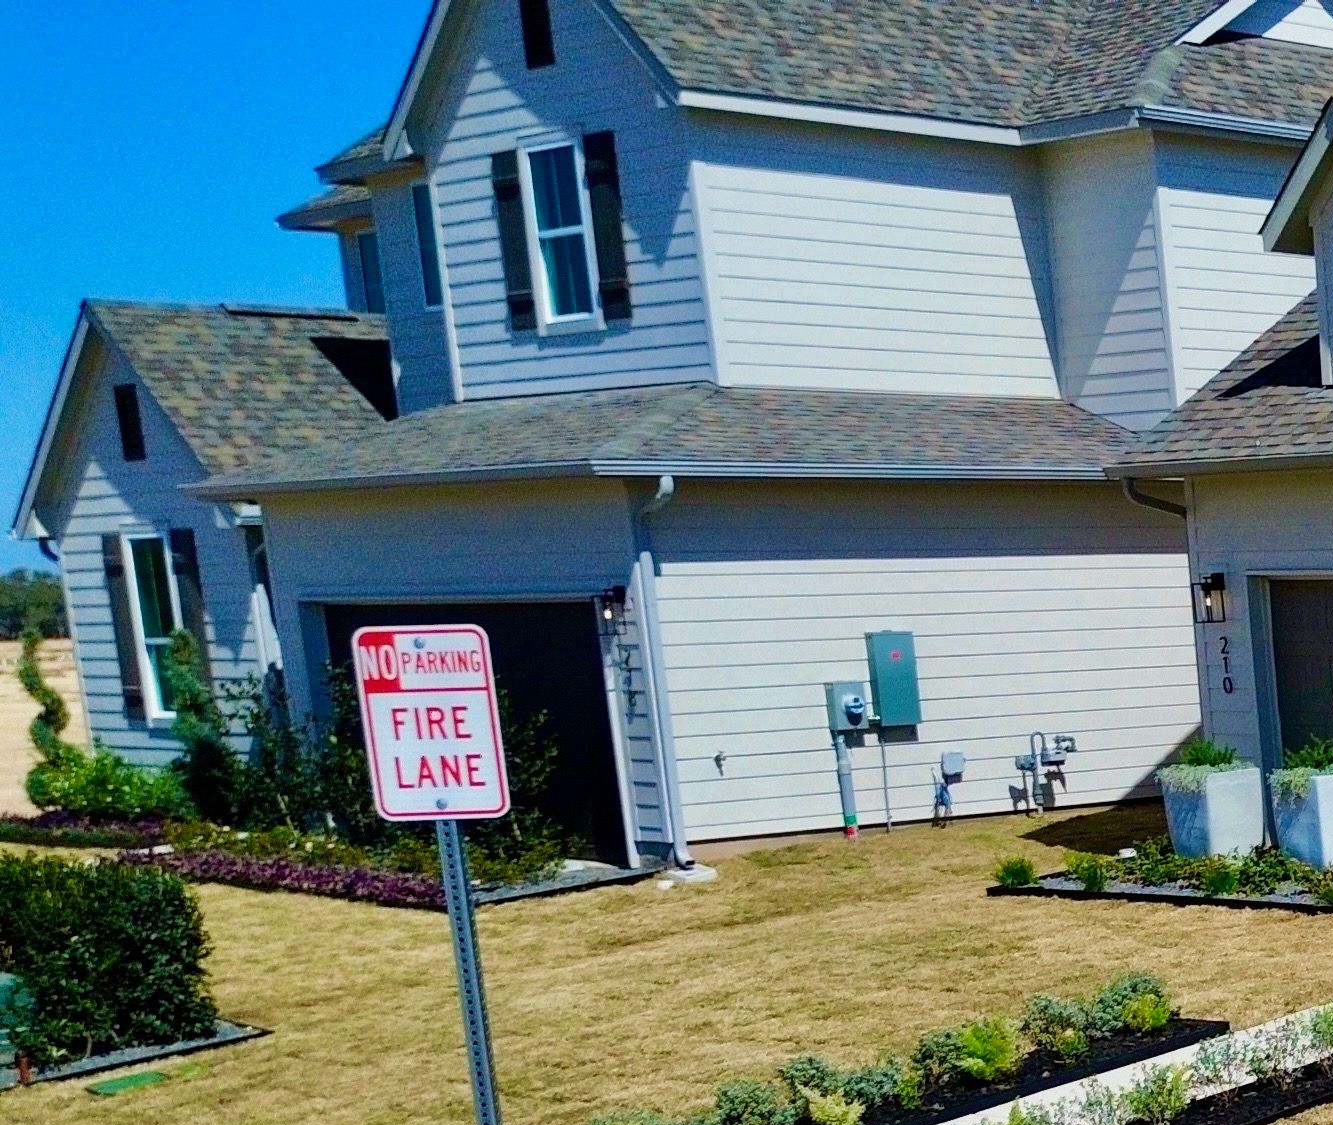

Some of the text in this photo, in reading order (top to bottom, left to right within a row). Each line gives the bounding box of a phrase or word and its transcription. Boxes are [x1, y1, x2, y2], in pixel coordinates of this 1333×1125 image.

[360, 645, 481, 681] NO PARKING
[1219, 636, 1233, 694] 210
[391, 706, 472, 740] FIRE
[394, 754, 486, 788] LANE
